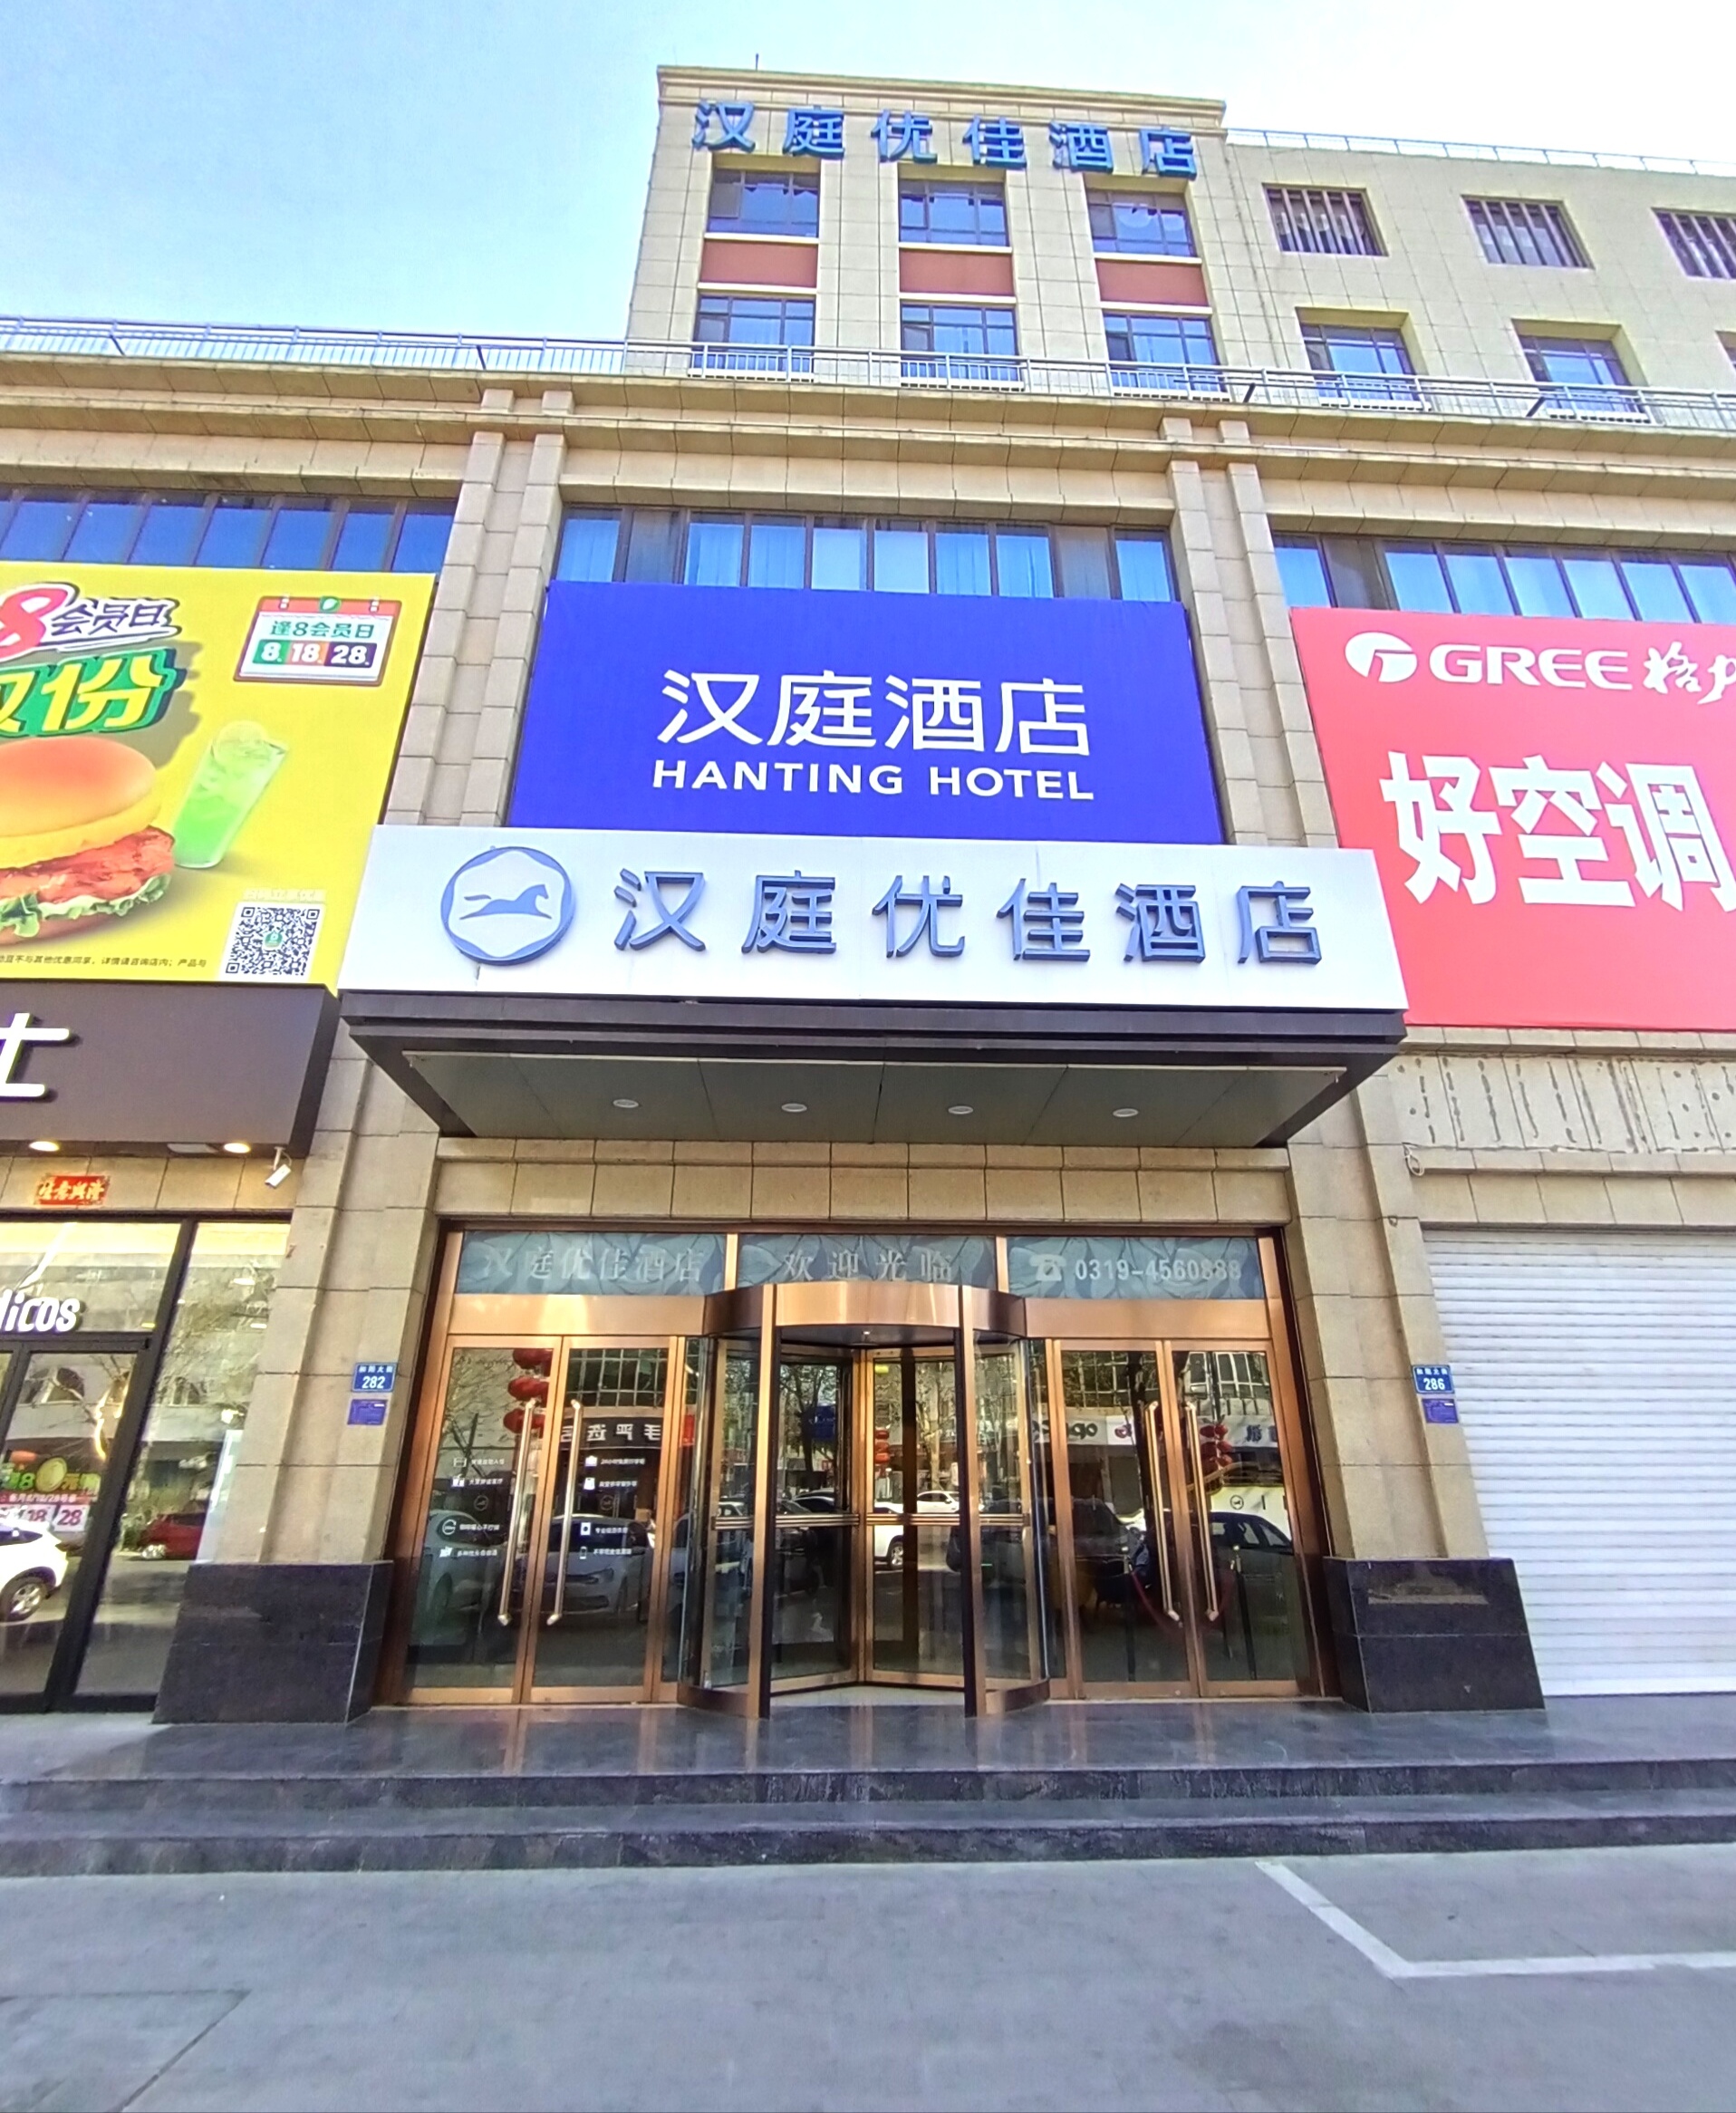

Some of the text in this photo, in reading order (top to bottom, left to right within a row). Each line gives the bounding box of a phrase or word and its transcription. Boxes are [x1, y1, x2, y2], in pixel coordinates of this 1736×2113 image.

[692, 99, 1198, 179] 汉庭优佳酒店
[271, 620, 375, 640] 逢8会员日
[1429, 643, 1633, 690] GREE
[657, 670, 1090, 757] 汉庭酒店
[652, 759, 1095, 801] HANTING HOTEL
[1379, 751, 1736, 912] 好空调
[613, 867, 1323, 966] 汉庭优佳酒店
[482, 1247, 705, 1282] 汉庭优佳酒店
[785, 1249, 952, 1282] 欢迎光临
[1075, 1259, 1242, 1280] 0319-4560888
[362, 1375, 386, 1389] 282
[1423, 1377, 1445, 1391] 286
[56, 1509, 83, 1526] 28
